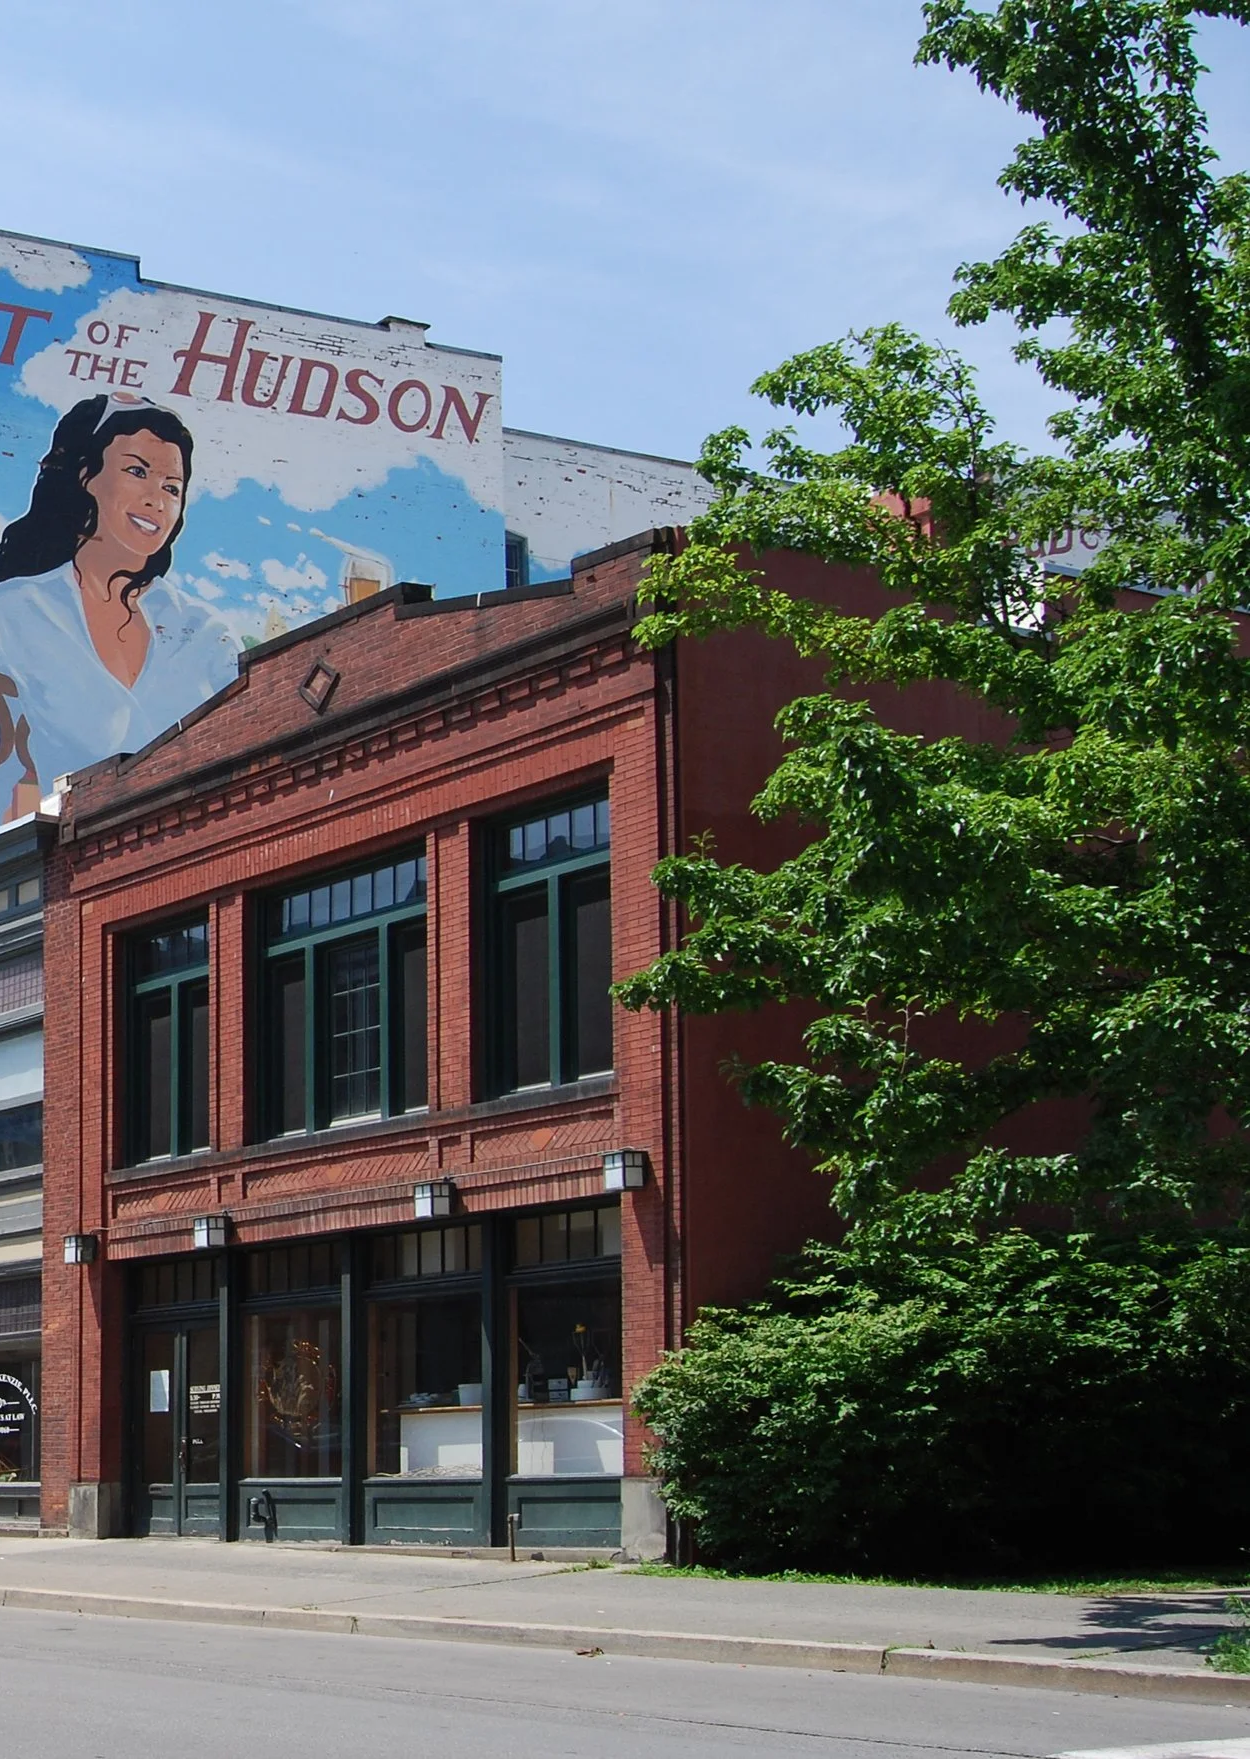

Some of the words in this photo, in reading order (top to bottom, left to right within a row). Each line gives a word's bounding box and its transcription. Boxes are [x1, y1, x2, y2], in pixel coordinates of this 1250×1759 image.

[87, 320, 140, 349] OF
[64, 349, 148, 389] THE
[169, 310, 495, 445] HUDSON
